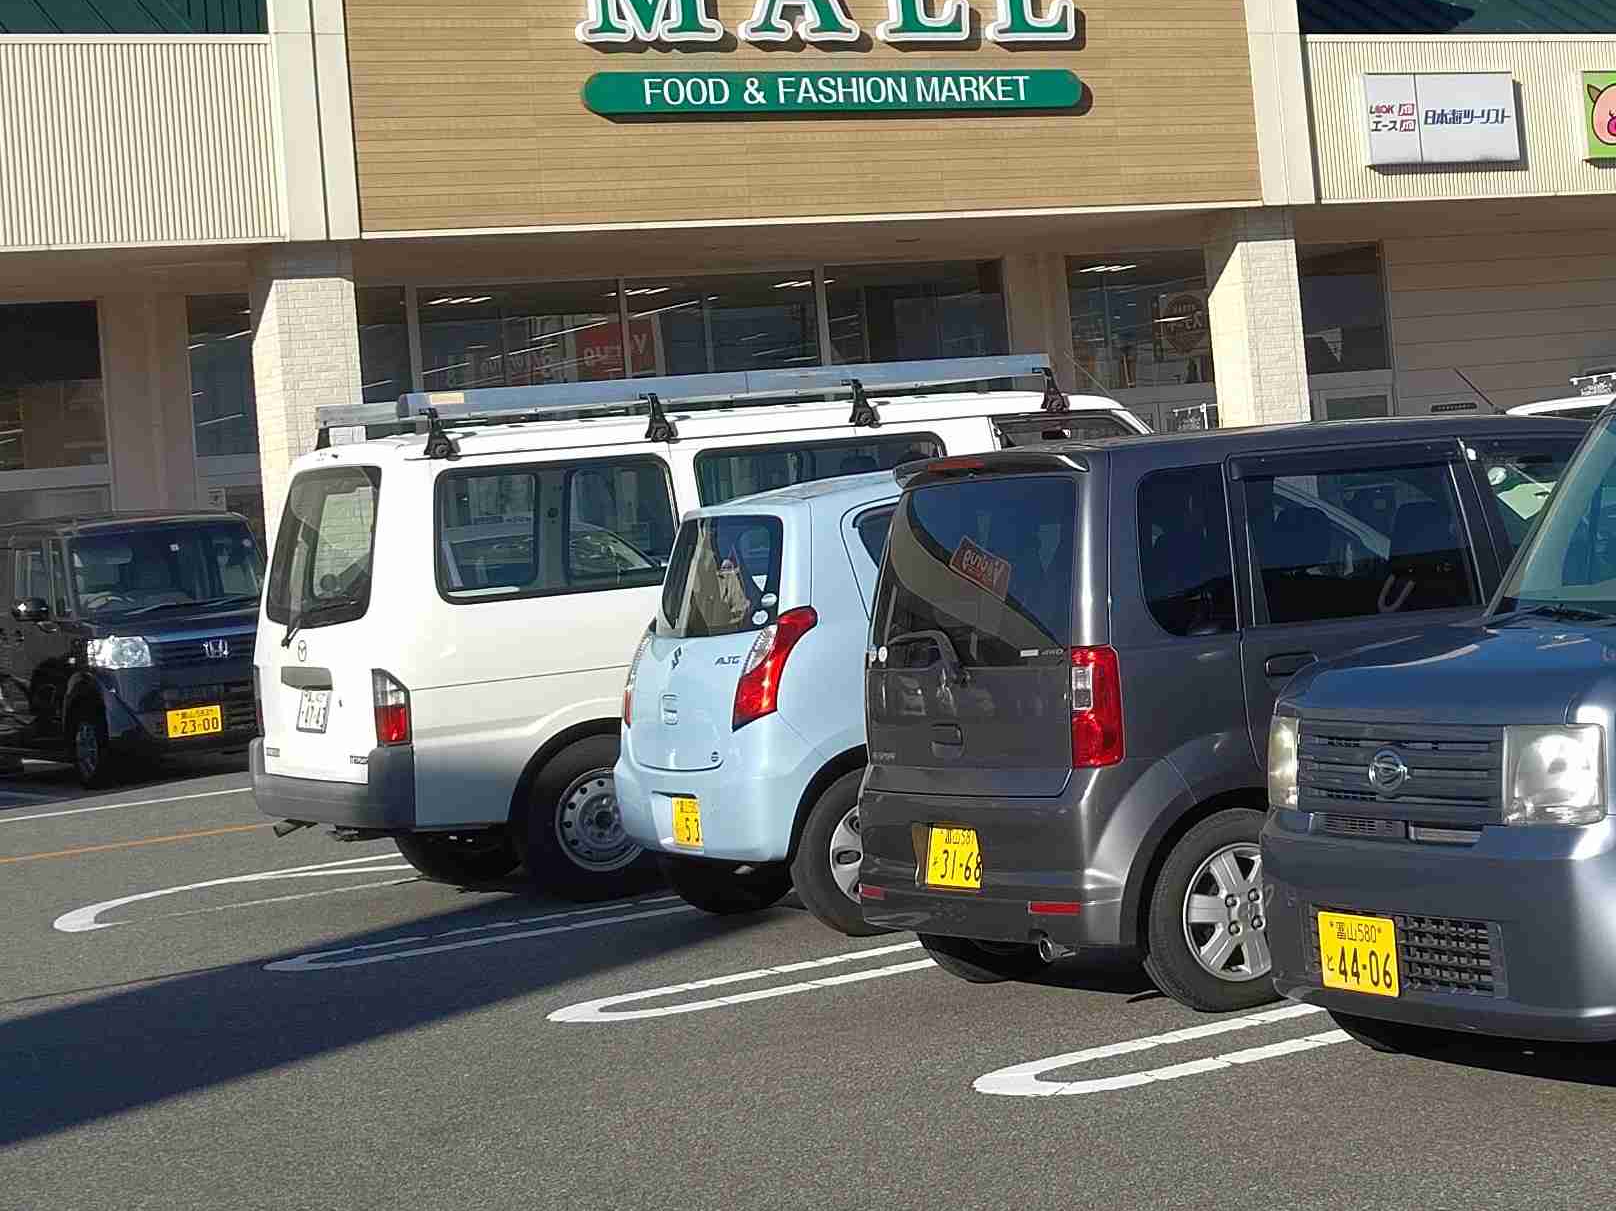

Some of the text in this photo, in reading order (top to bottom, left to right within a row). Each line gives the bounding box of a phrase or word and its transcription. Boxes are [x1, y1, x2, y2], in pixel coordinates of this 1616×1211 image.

[643, 75, 1030, 106] FOOD & FASHION MARKET
[940, 849, 983, 882] 31-68
[1335, 921, 1377, 943] 富山580
[1338, 946, 1393, 989] 44-06
